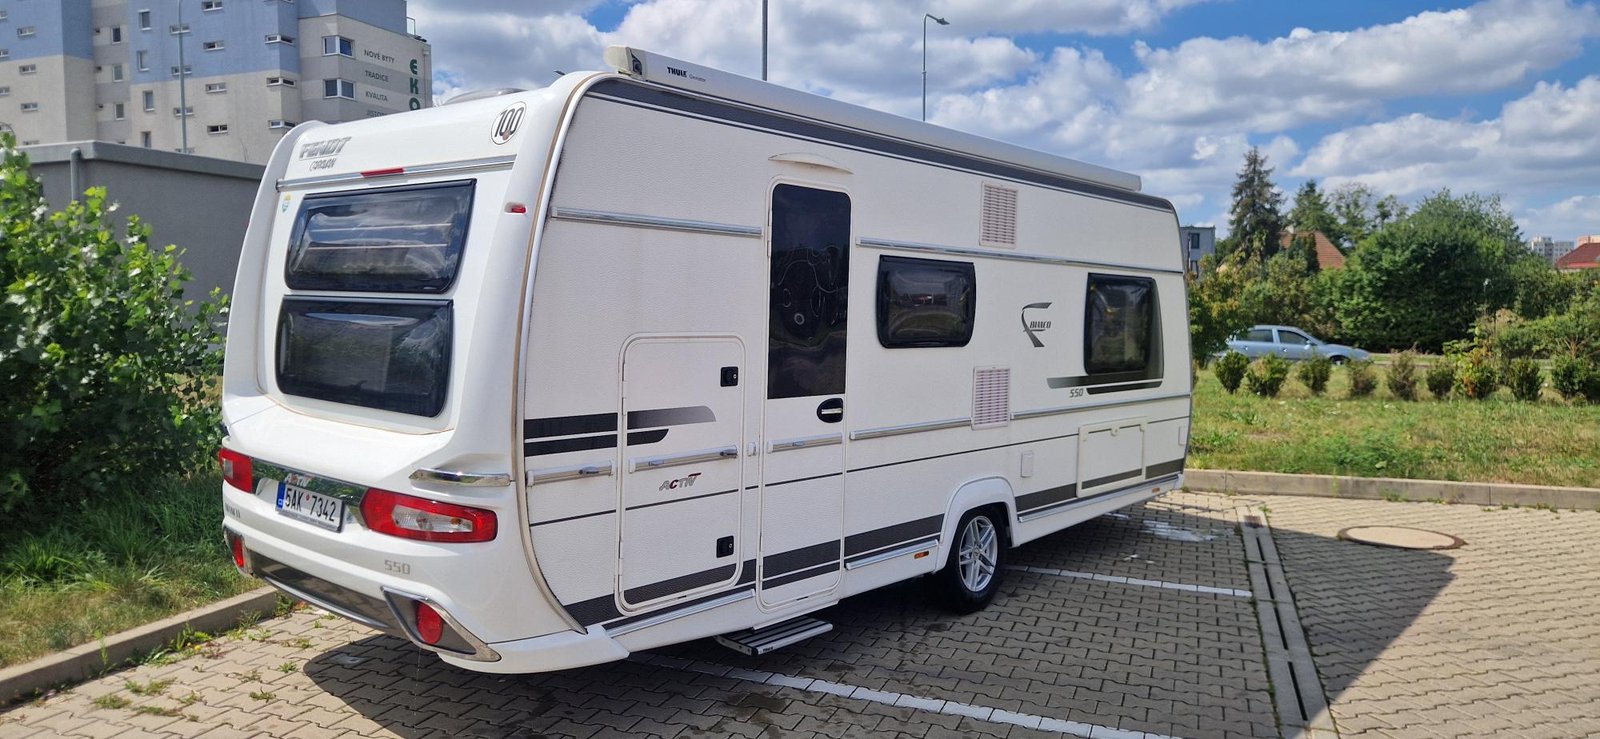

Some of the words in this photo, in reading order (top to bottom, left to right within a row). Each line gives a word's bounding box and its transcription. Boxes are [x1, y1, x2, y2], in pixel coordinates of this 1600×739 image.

[381, 54, 395, 63] BYTY
[365, 70, 389, 82] TRADICE
[667, 66, 687, 78] THULE
[365, 91, 388, 101] KVALITA
[494, 106, 525, 138] 100
[299, 136, 352, 159] FENDT
[1069, 388, 1084, 398] 550
[658, 472, 702, 491] ACTIV
[285, 488, 304, 512] 5AK
[309, 495, 337, 522] 7342
[384, 559, 411, 575] 550
